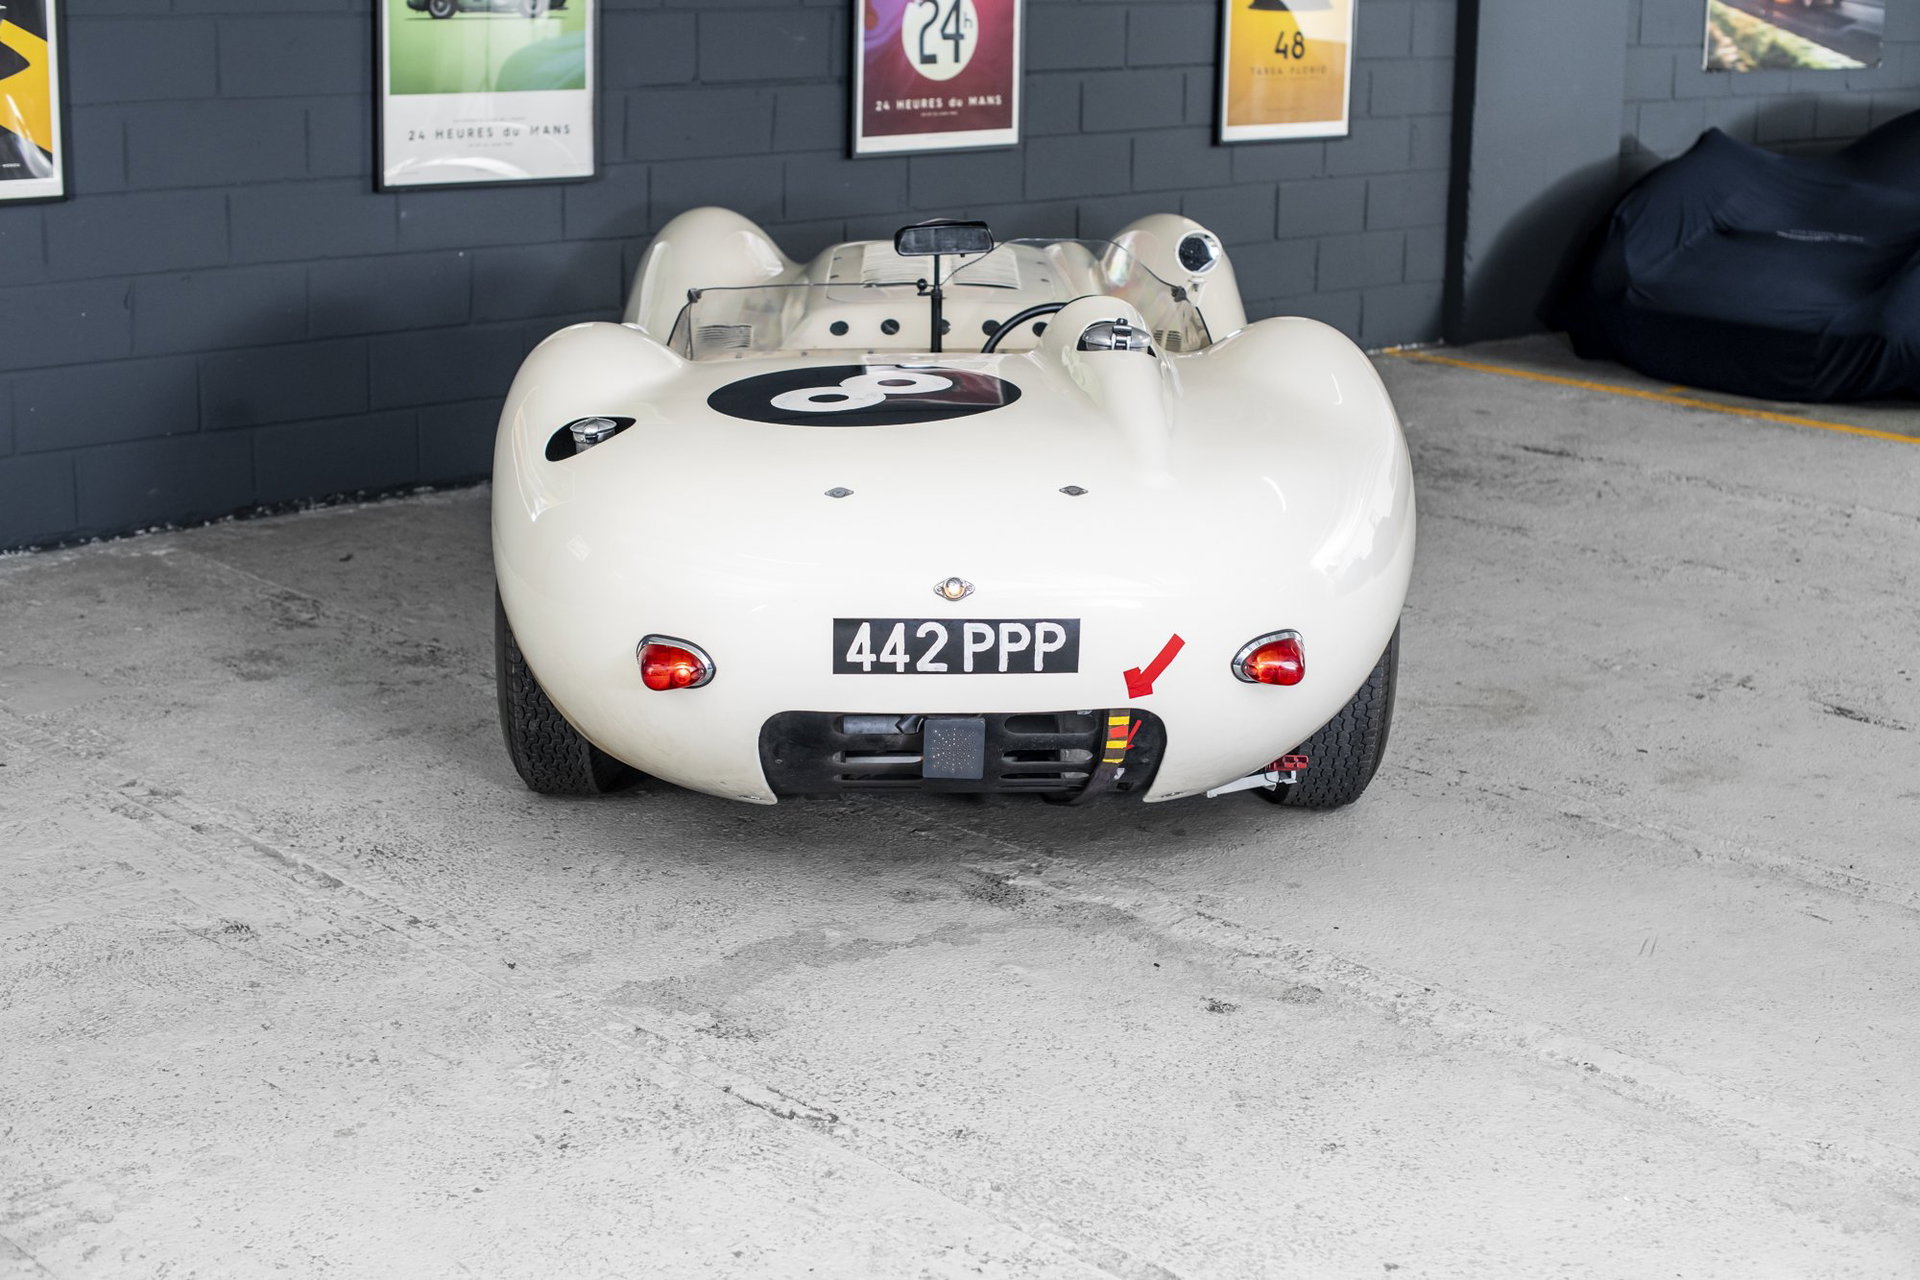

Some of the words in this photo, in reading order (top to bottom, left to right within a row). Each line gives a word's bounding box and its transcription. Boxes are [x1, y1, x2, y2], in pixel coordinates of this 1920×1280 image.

[1274, 31, 1305, 59] 48
[875, 101, 890, 111] 24
[896, 98, 943, 110] HEURES
[968, 95, 1002, 106] MANS
[408, 130, 425, 141] 24
[435, 127, 493, 139] HEURES
[502, 127, 520, 138] du
[770, 371, 953, 413] 8
